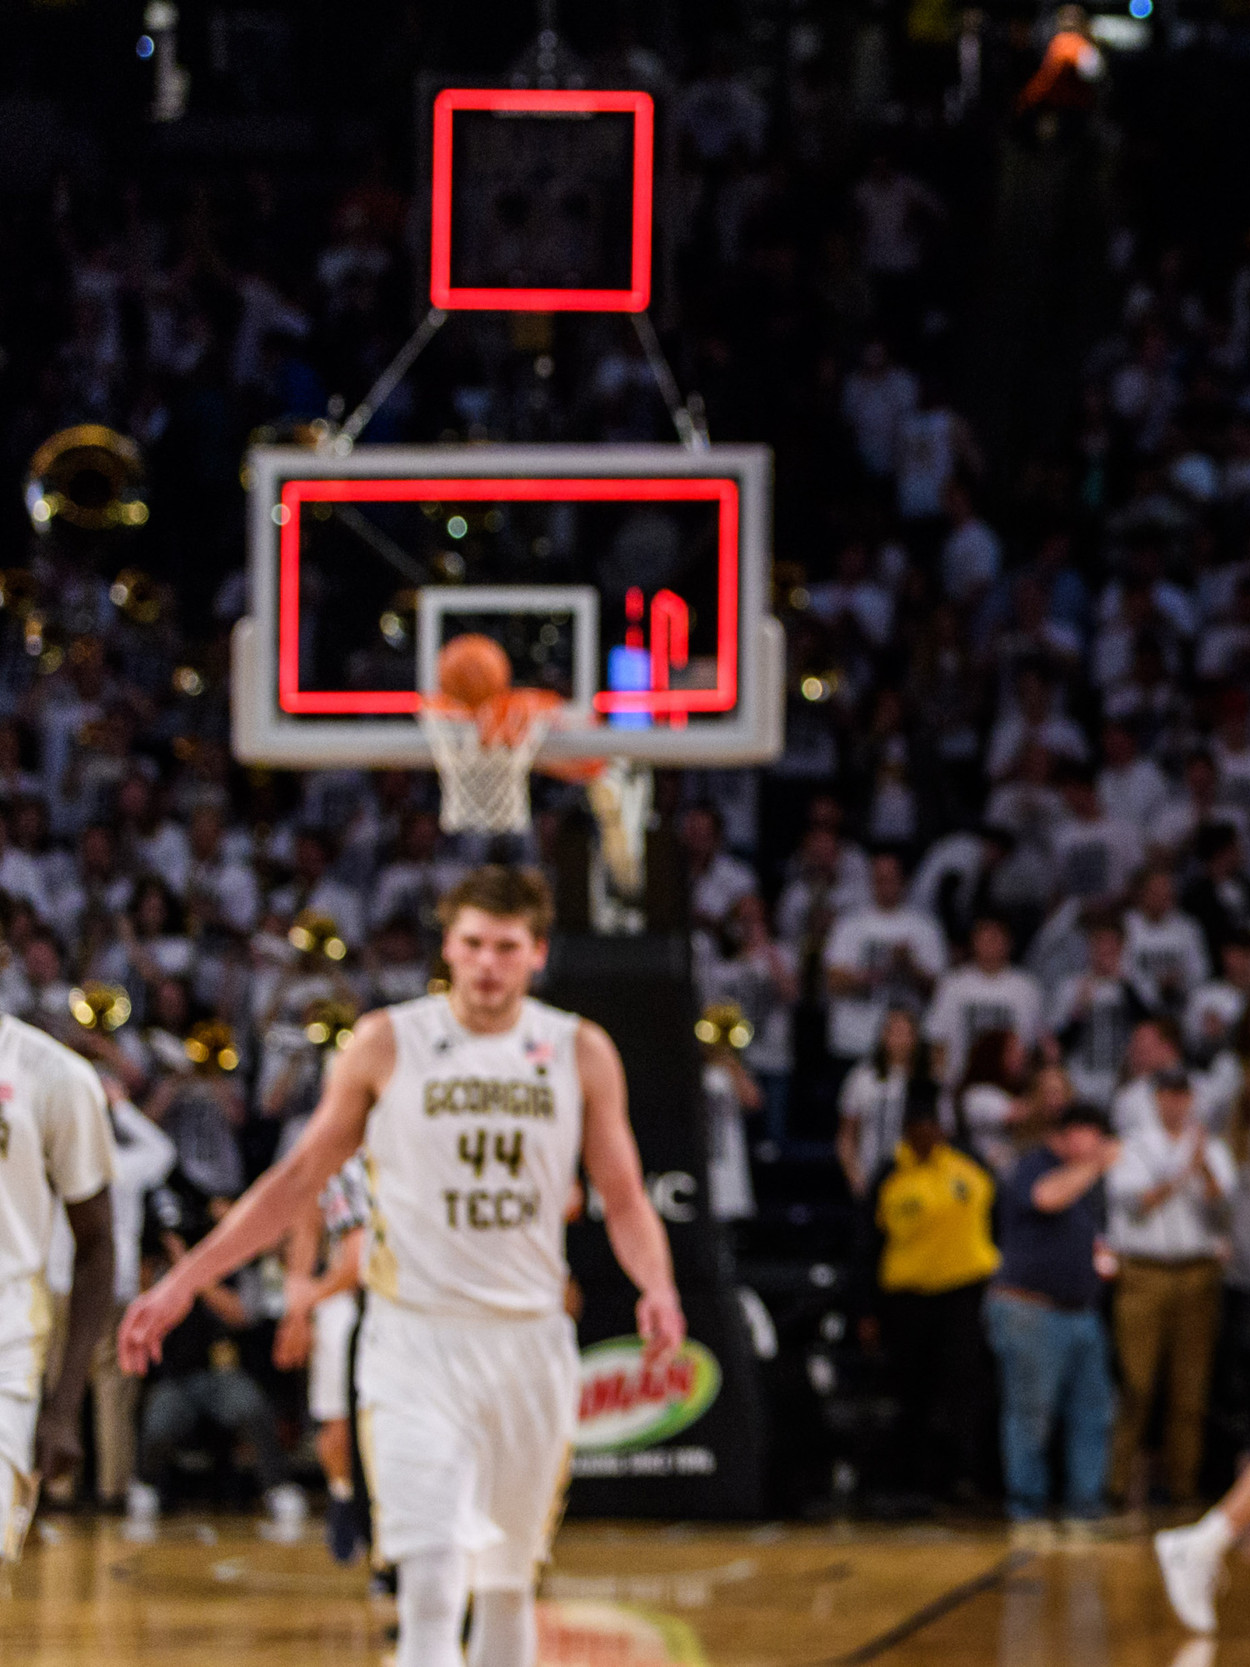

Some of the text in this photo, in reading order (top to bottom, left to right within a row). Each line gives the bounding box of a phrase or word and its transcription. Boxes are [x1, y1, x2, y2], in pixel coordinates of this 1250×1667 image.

[426, 1078, 553, 1118] GEORGIA
[459, 1129, 523, 1179] 44
[443, 1190, 541, 1228] TECH
